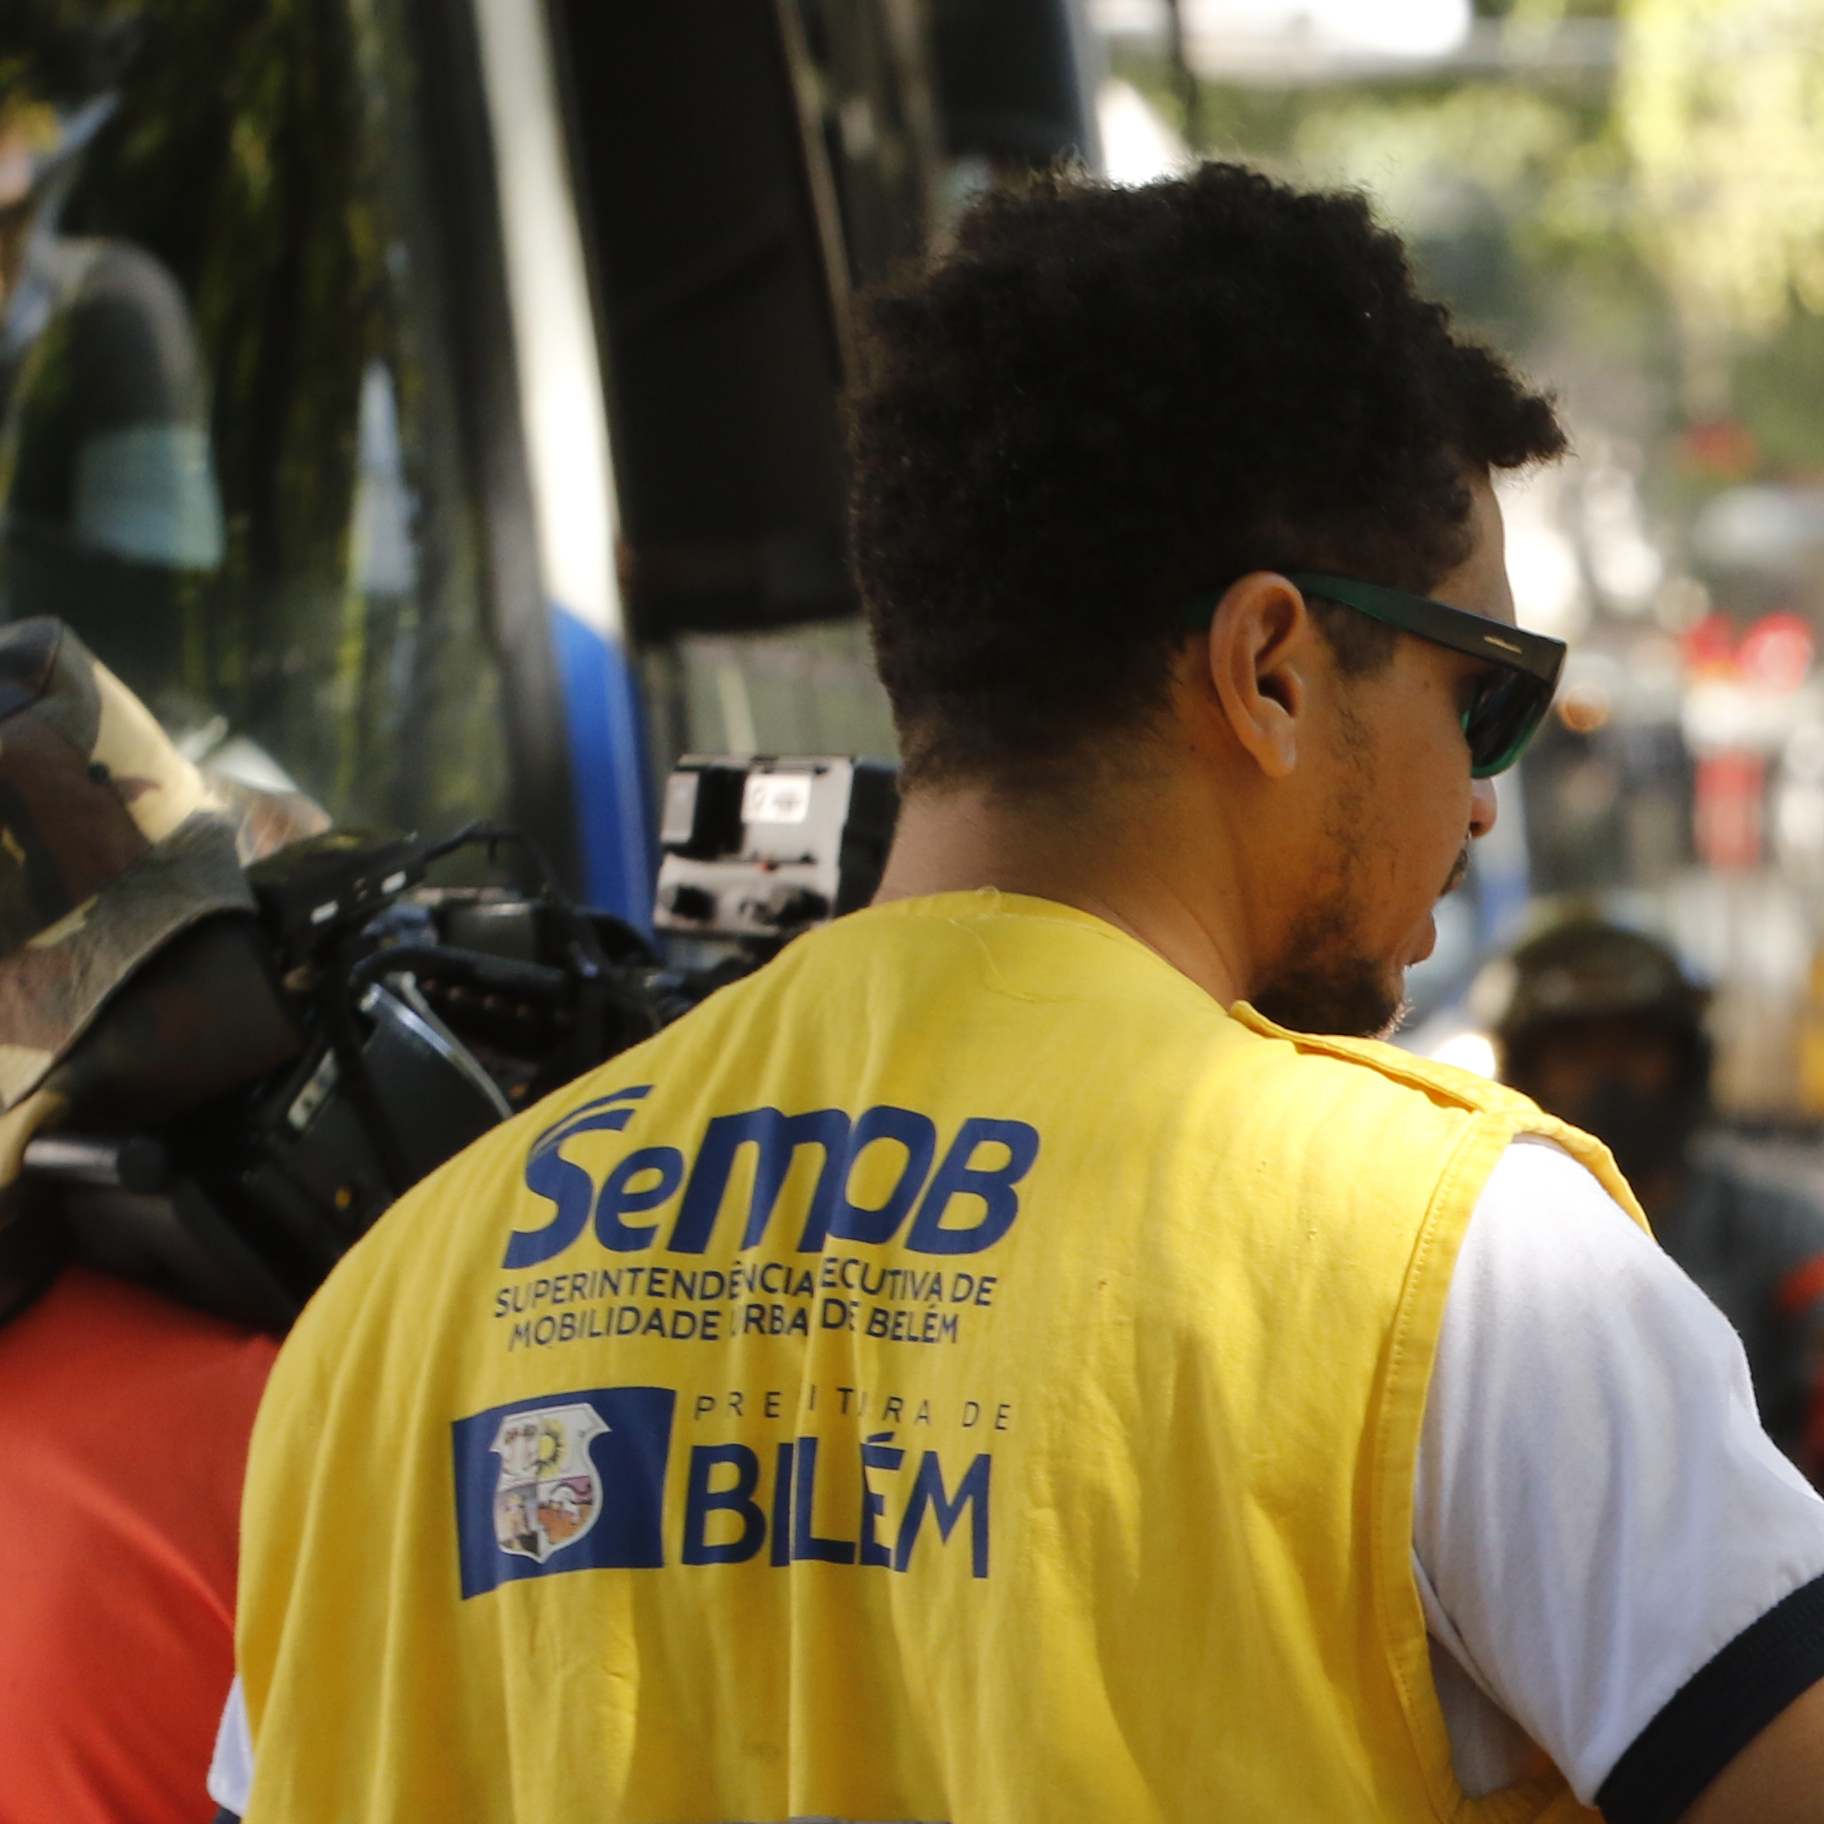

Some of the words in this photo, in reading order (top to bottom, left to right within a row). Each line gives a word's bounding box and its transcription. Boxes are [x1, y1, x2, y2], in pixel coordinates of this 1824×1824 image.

[494, 1260, 814, 1318] SUPERINTENDÊNCIA
[821, 1257, 942, 1302] ECUTIVA
[951, 1273, 998, 1306] DE
[507, 1305, 722, 1352] MOBILIDADE
[865, 1303, 959, 1344] BELÉM
[961, 1401, 1012, 1431] DE
